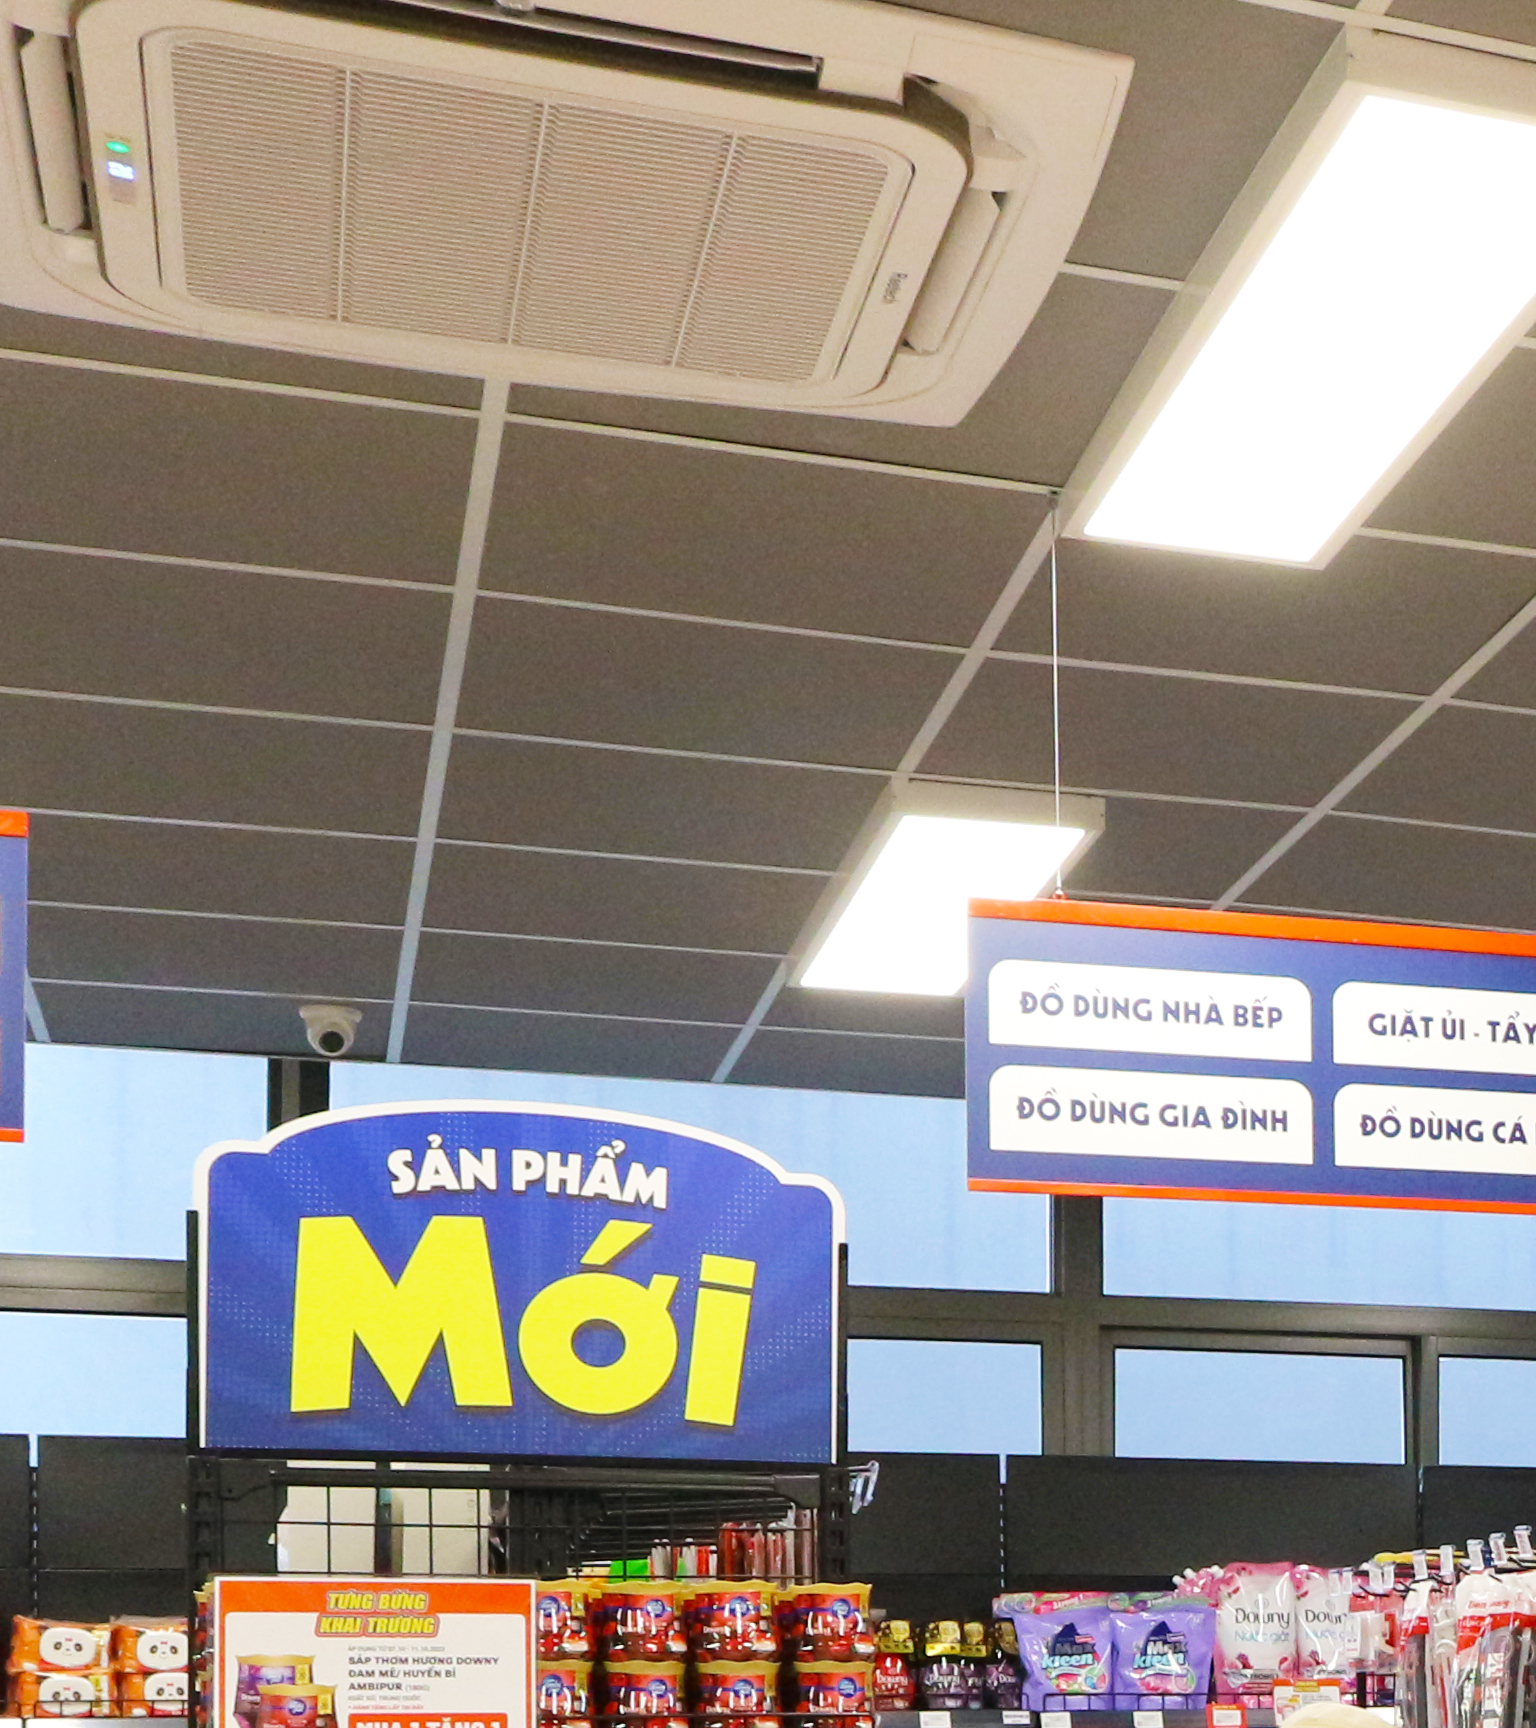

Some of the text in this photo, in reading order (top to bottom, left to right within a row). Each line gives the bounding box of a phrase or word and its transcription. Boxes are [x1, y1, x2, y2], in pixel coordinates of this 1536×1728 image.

[1020, 981, 1284, 1030] ĐỒ DÙNG NHÀ BẾP
[1368, 1012, 1432, 1047] GIẶT
[1441, 1012, 1466, 1042] ỦI
[1017, 1087, 1289, 1133] ĐỒ DÙNG GIA ĐÌNH
[1360, 1104, 1402, 1139] ĐỒ
[1410, 1109, 1484, 1145] DÙNG
[1492, 1112, 1529, 1145] CÁ
[387, 1135, 668, 1210] SẢN PHẨM
[290, 1215, 757, 1428] Mới
